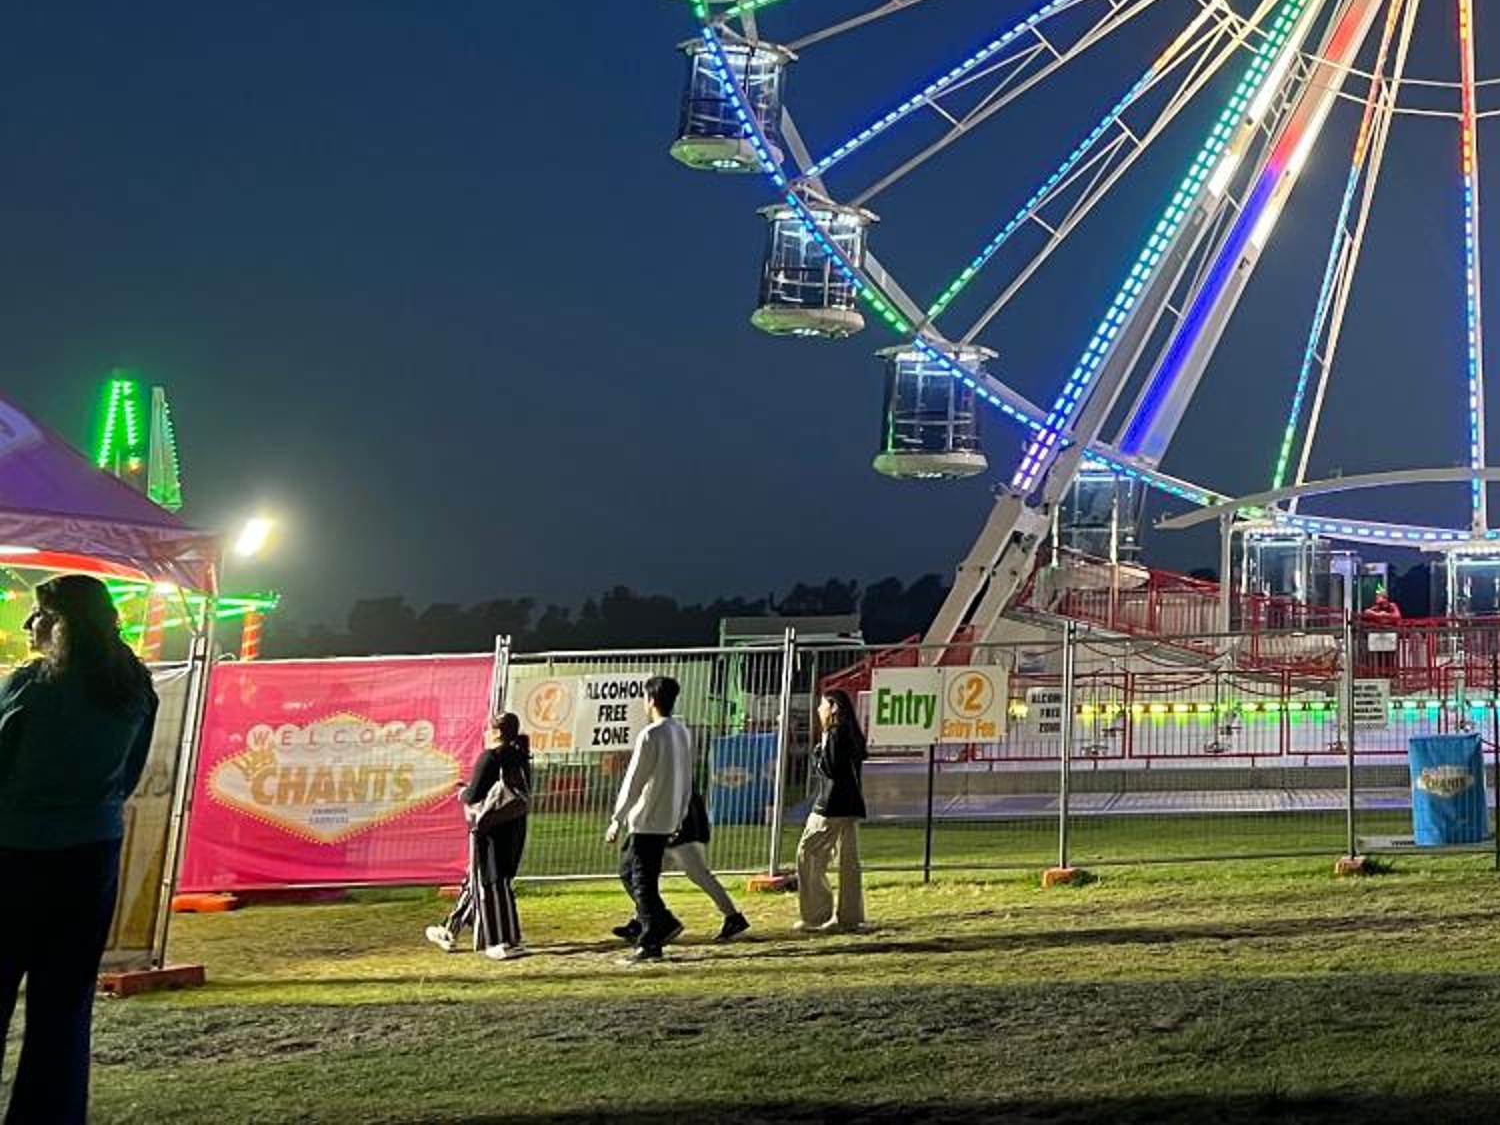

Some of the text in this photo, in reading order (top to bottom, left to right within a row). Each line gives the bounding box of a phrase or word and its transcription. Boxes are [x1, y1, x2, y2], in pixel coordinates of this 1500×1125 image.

[533, 687, 562, 723] $2
[876, 688, 937, 729] Entry
[957, 676, 984, 712] $2
[597, 704, 627, 723] FREE
[252, 728, 428, 746] WELCOME
[591, 727, 630, 746] ZONE
[251, 763, 415, 805] CHANTS
